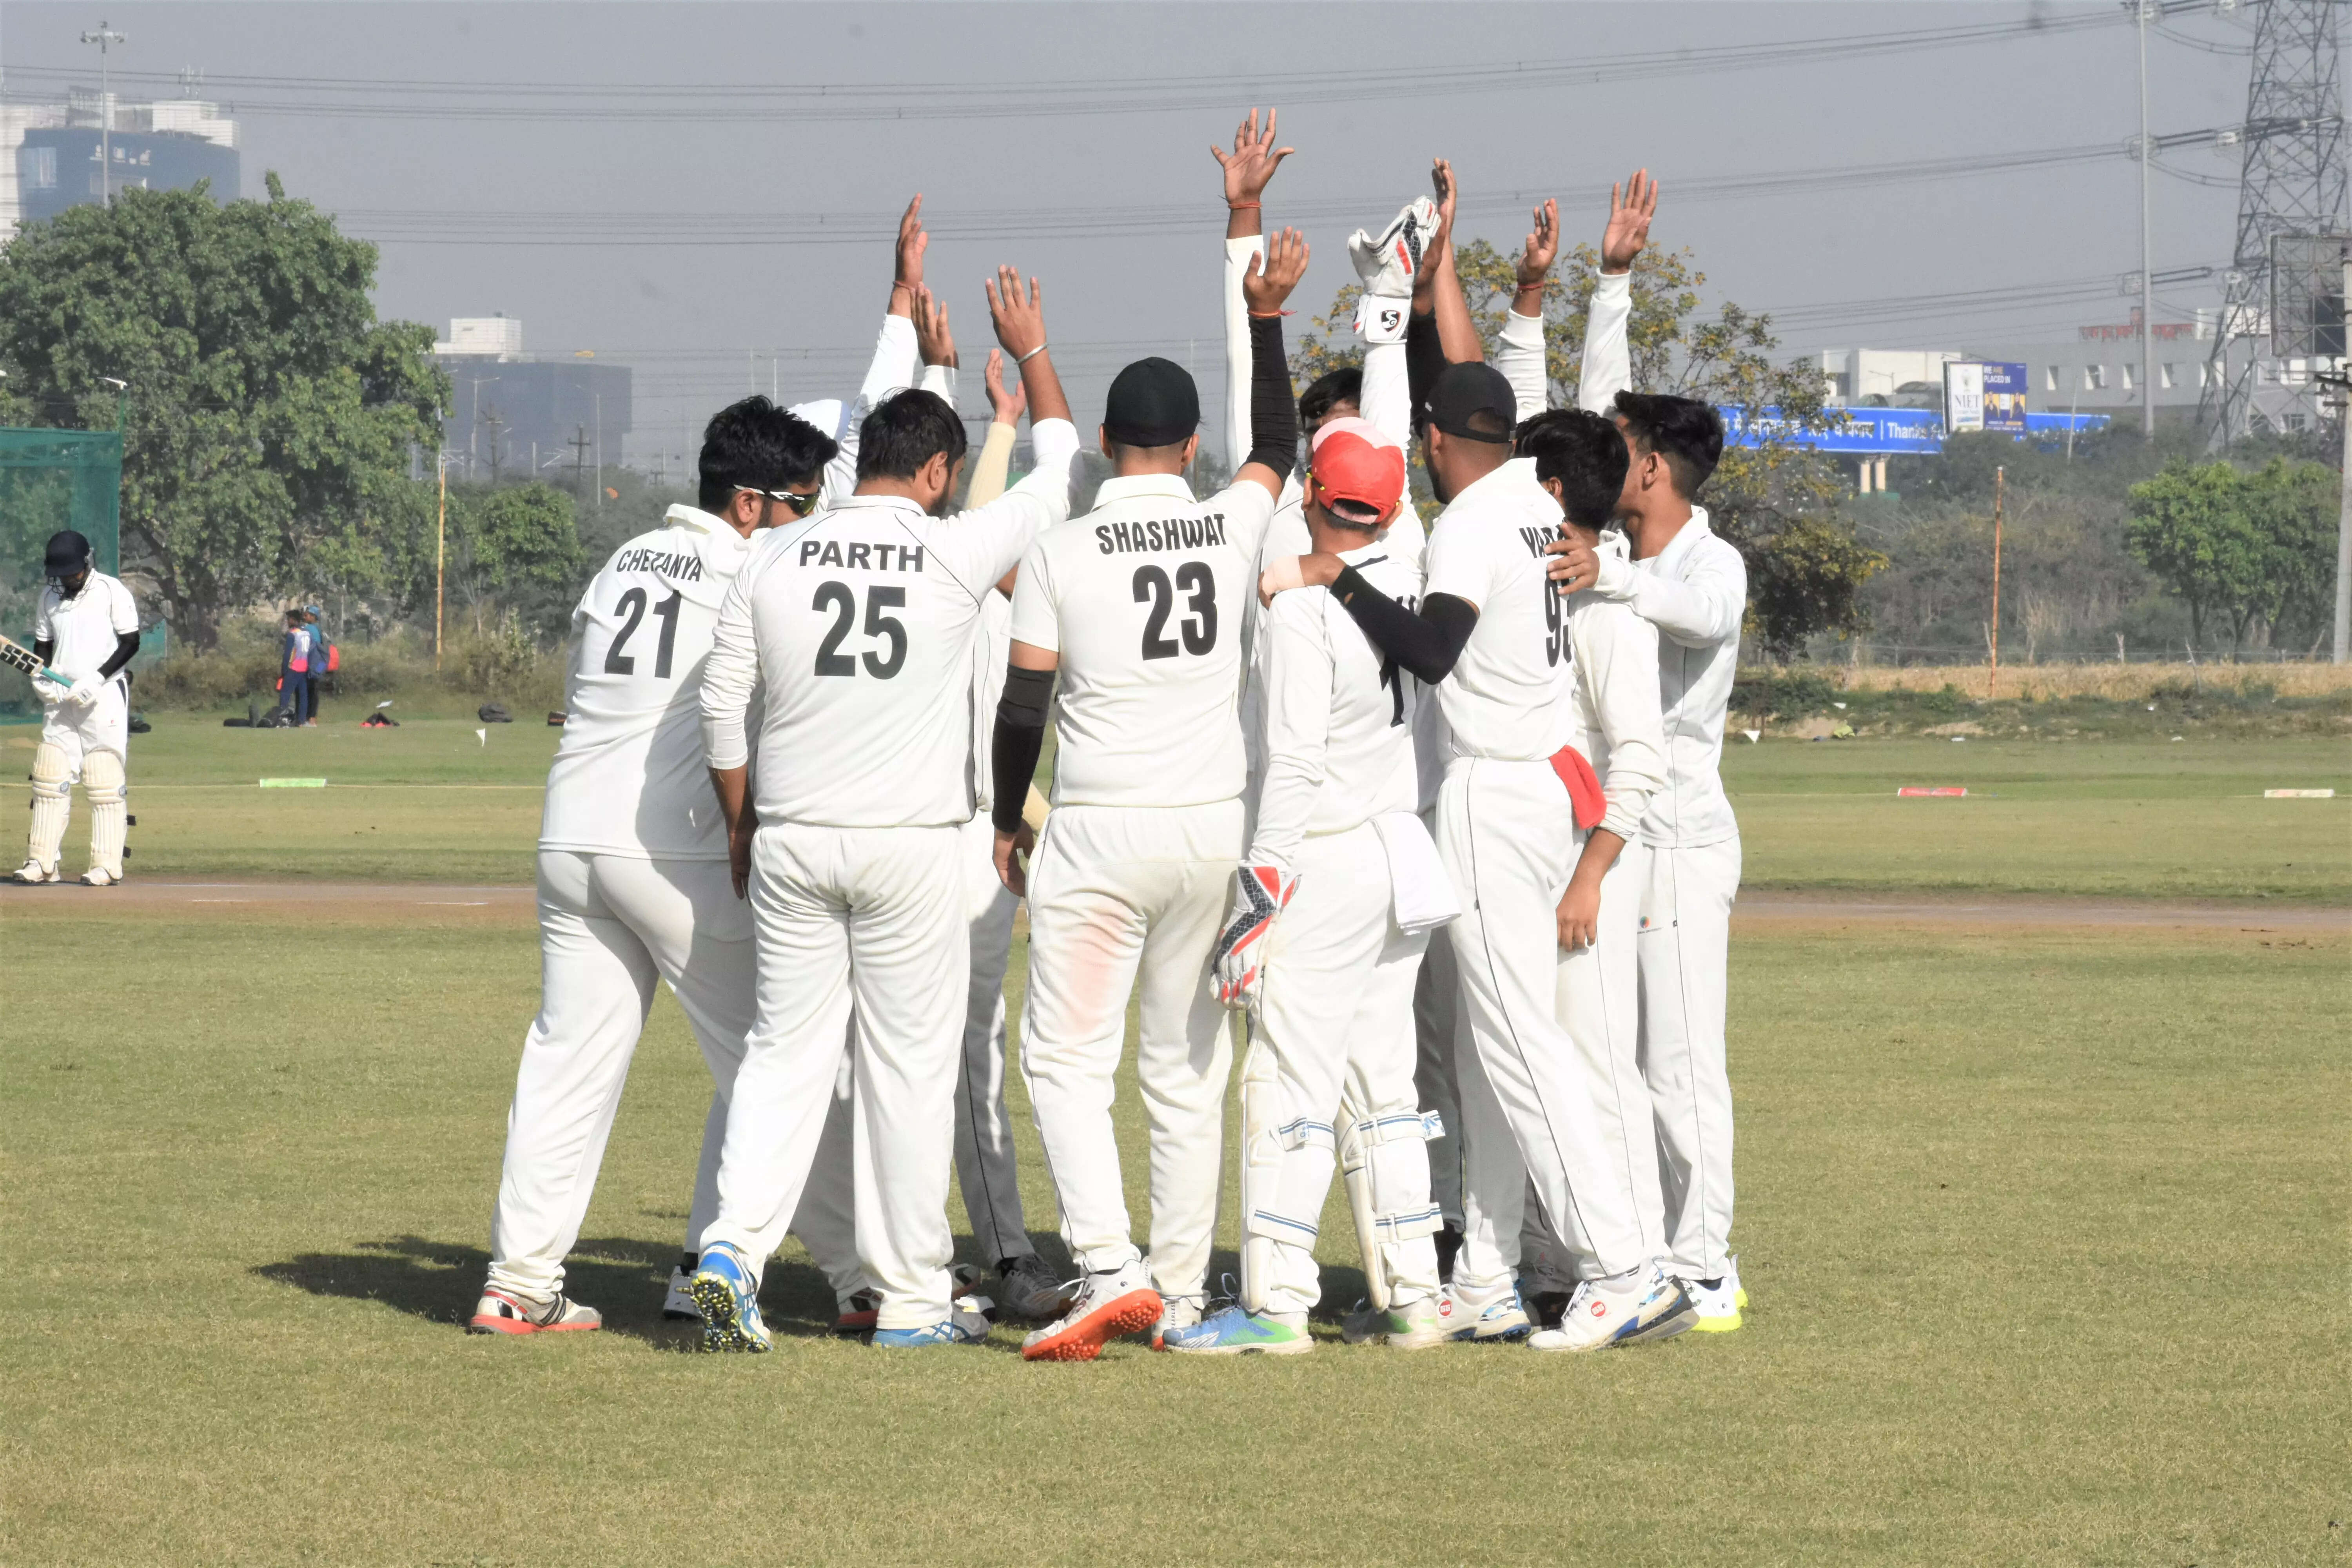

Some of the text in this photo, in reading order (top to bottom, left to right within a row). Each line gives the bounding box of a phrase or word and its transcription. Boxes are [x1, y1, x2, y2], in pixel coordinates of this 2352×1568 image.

[1095, 514, 1227, 555] SHASHWAT
[616, 549, 702, 582] CHETANYA
[800, 541, 924, 572] PARTH
[812, 581, 907, 680] 25
[1132, 562, 1217, 661] 23
[301, 635, 311, 652] 10
[604, 587, 681, 679] 21
